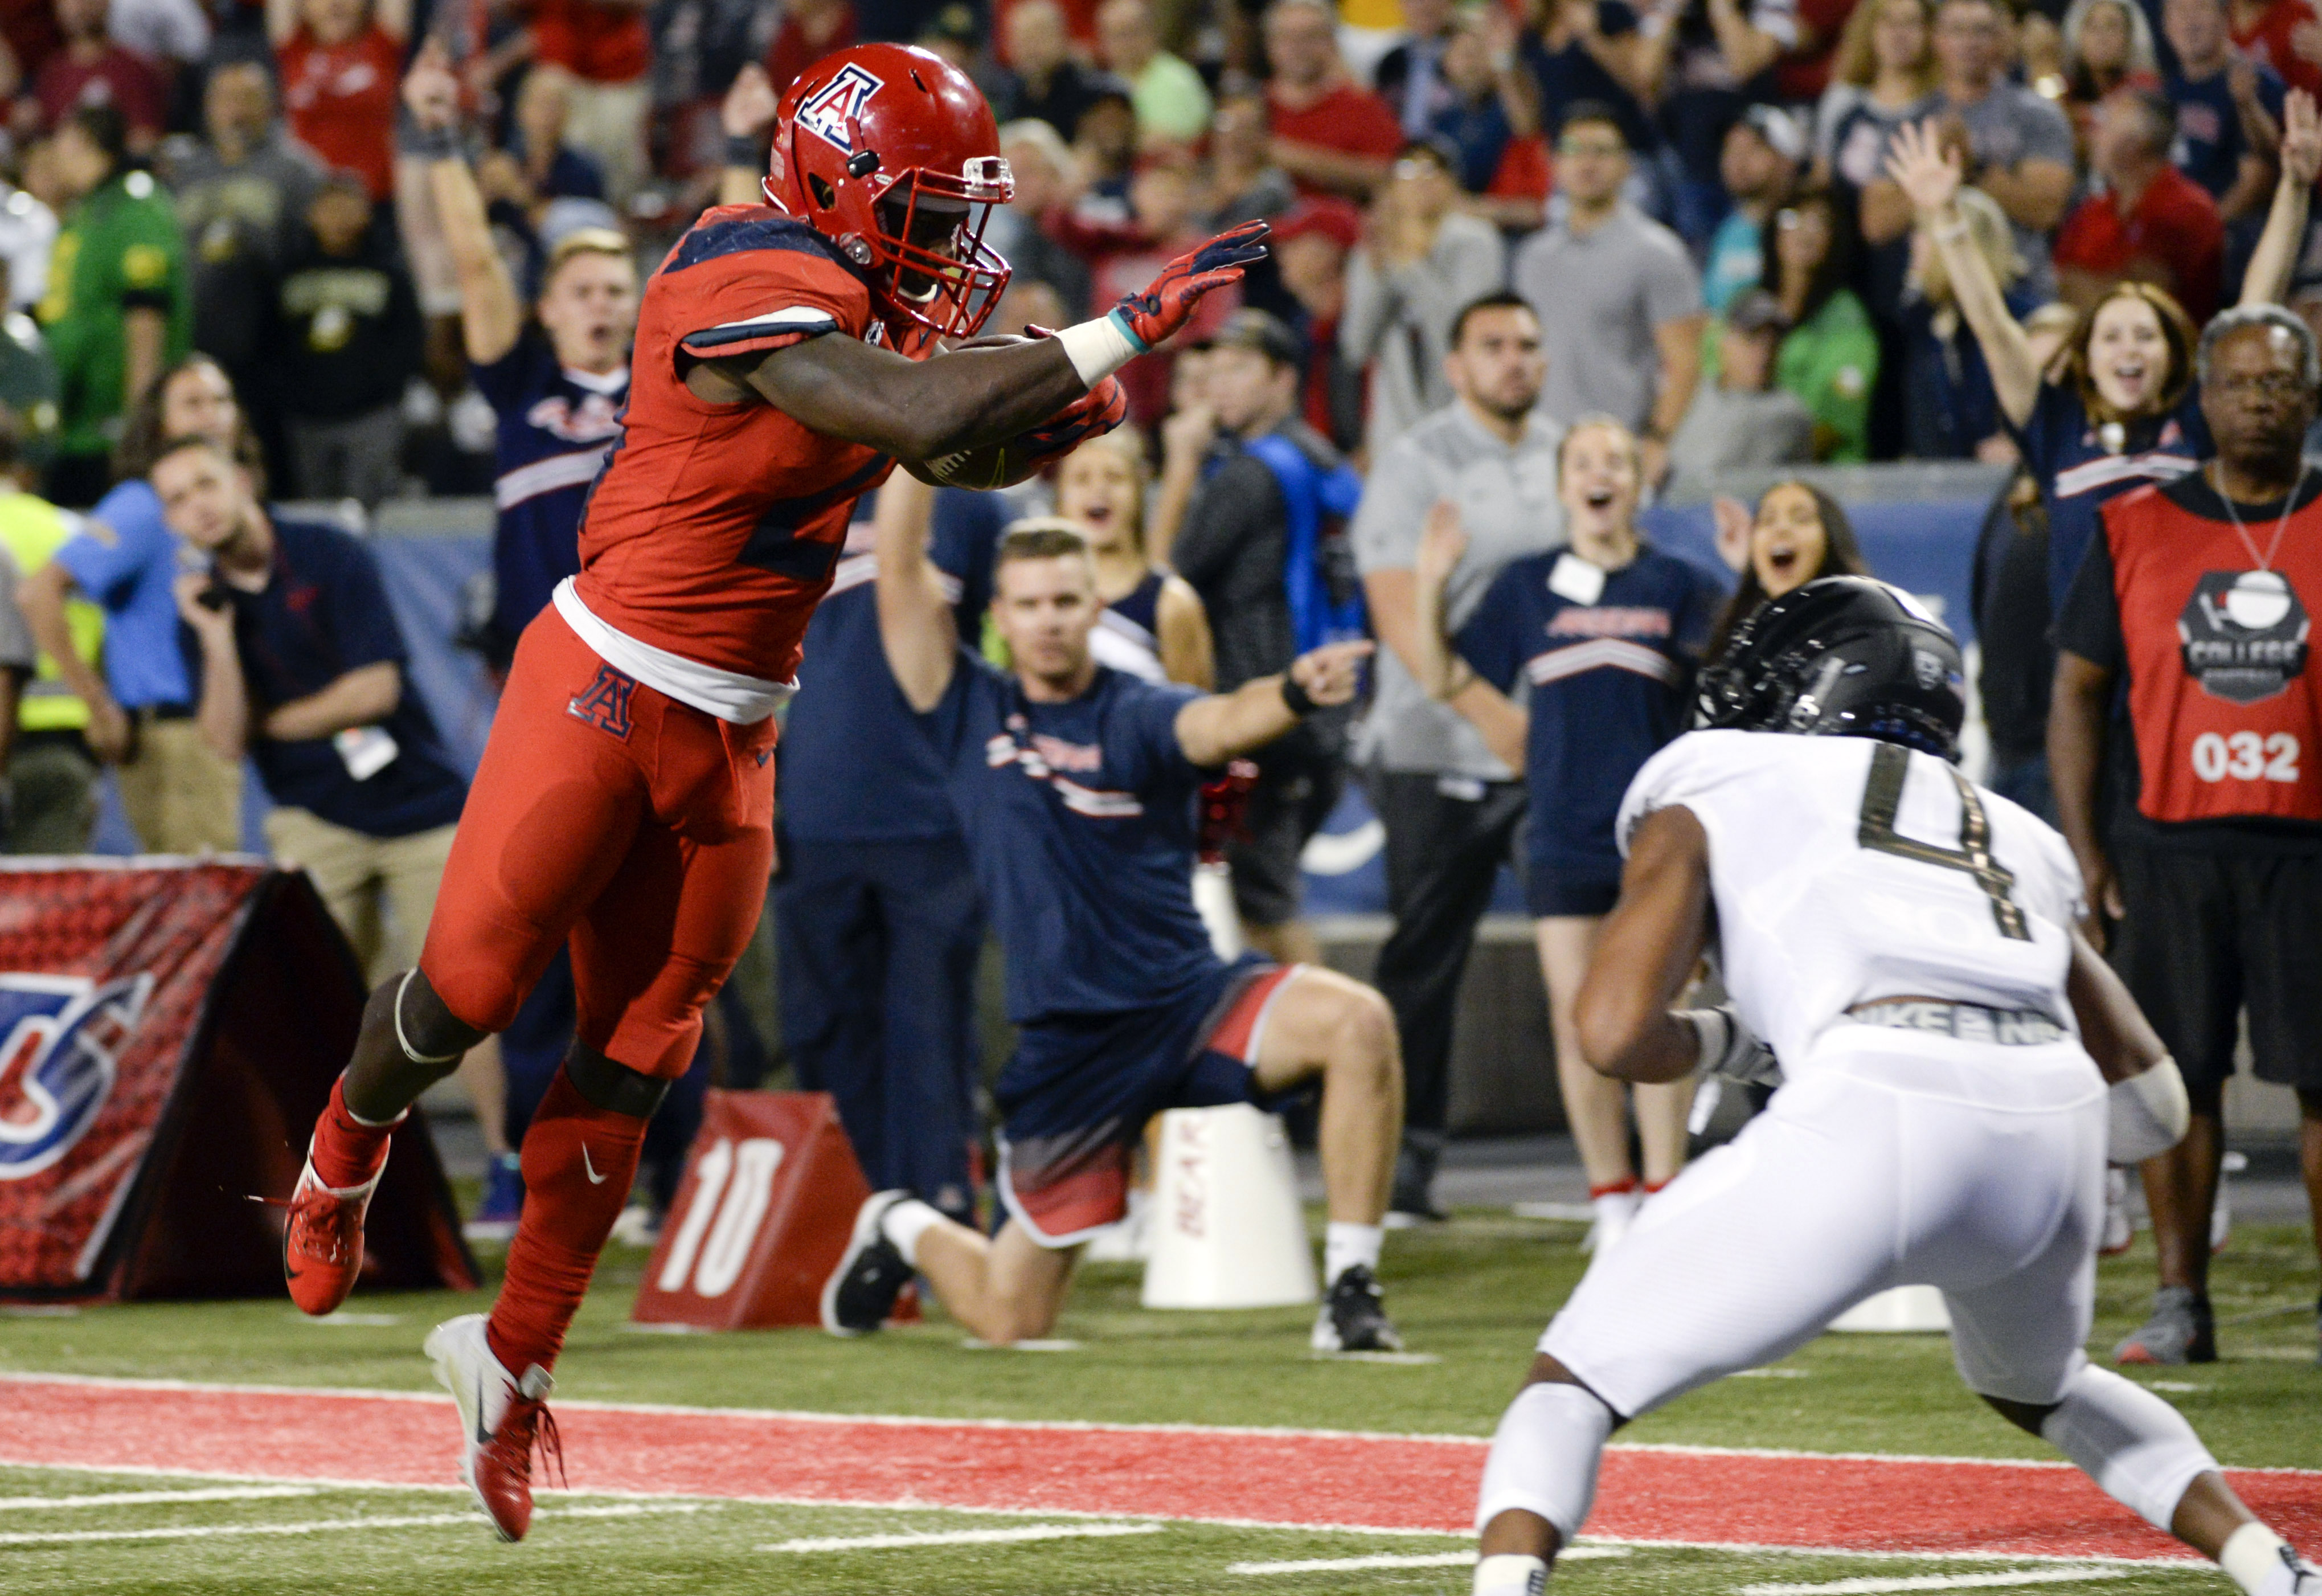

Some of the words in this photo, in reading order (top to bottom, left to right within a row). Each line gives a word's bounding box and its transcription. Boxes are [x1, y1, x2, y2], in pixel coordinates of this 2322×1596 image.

[2192, 731, 2300, 783] 032
[1858, 742, 2036, 943] 4
[658, 1136, 784, 1299] 10
